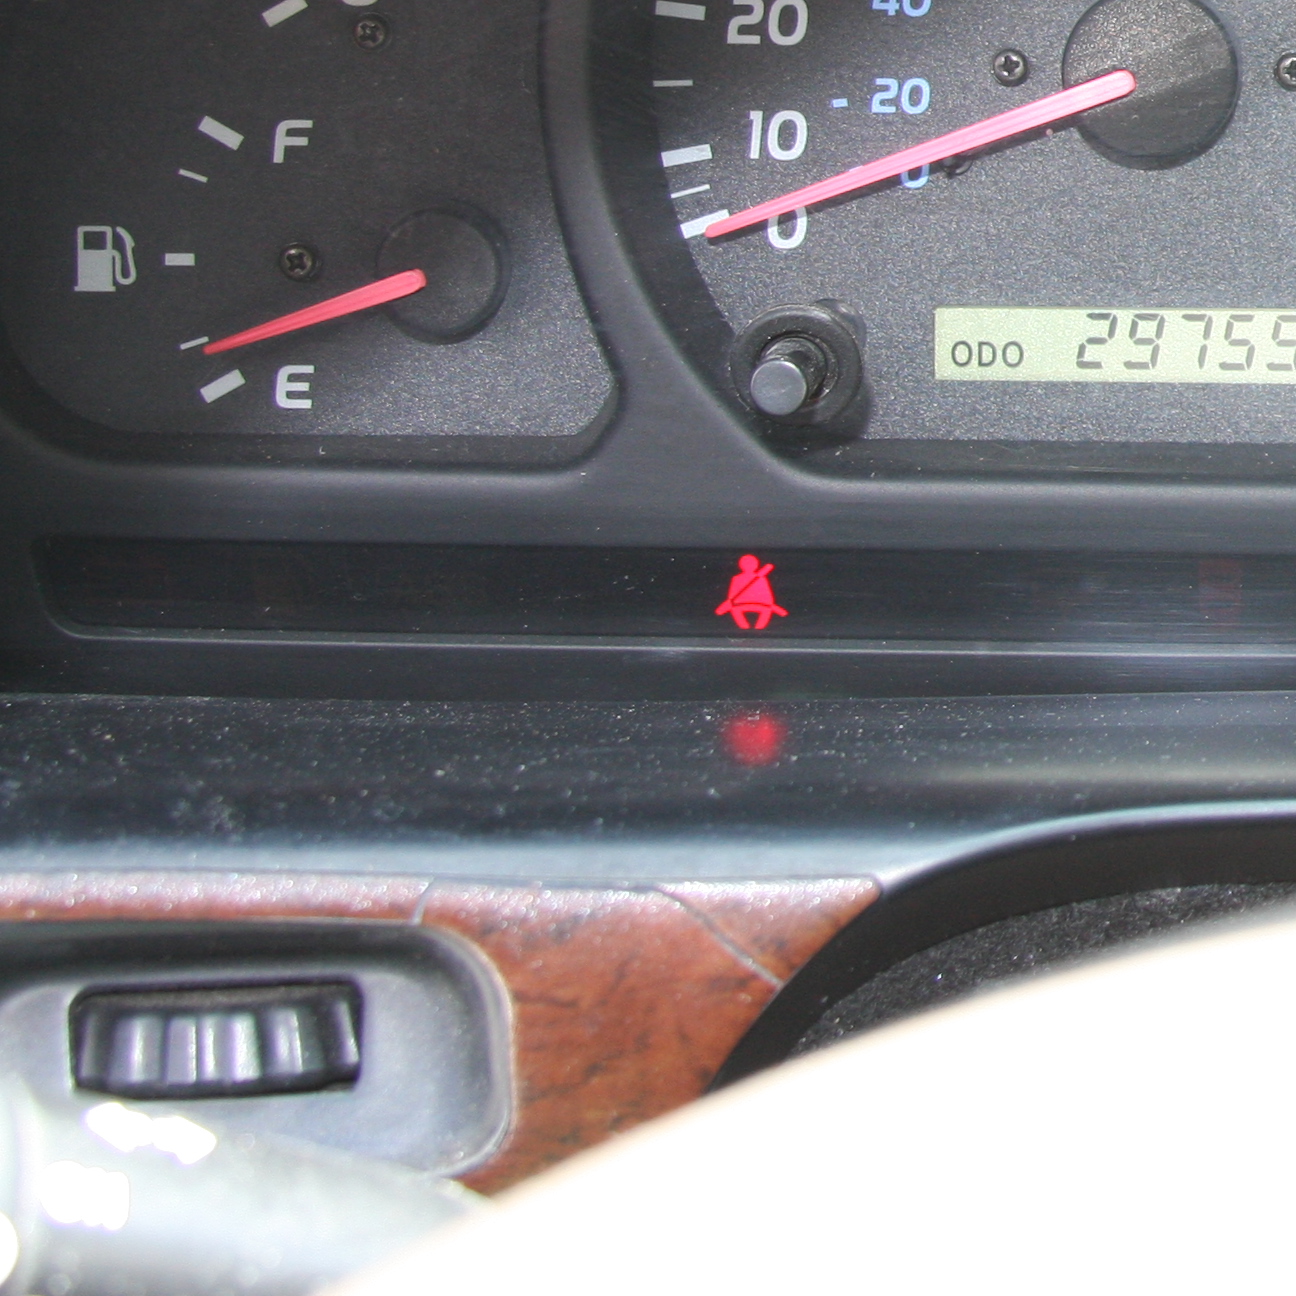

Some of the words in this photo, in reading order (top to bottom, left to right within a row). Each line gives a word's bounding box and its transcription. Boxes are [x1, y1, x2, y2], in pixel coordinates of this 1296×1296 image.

[870, 78, 930, 114] 20
[273, 120, 313, 163] F
[749, 111, 807, 160] 10
[767, 204, 807, 249] 0
[951, 340, 1024, 368] ODO
[274, 366, 314, 409] E
